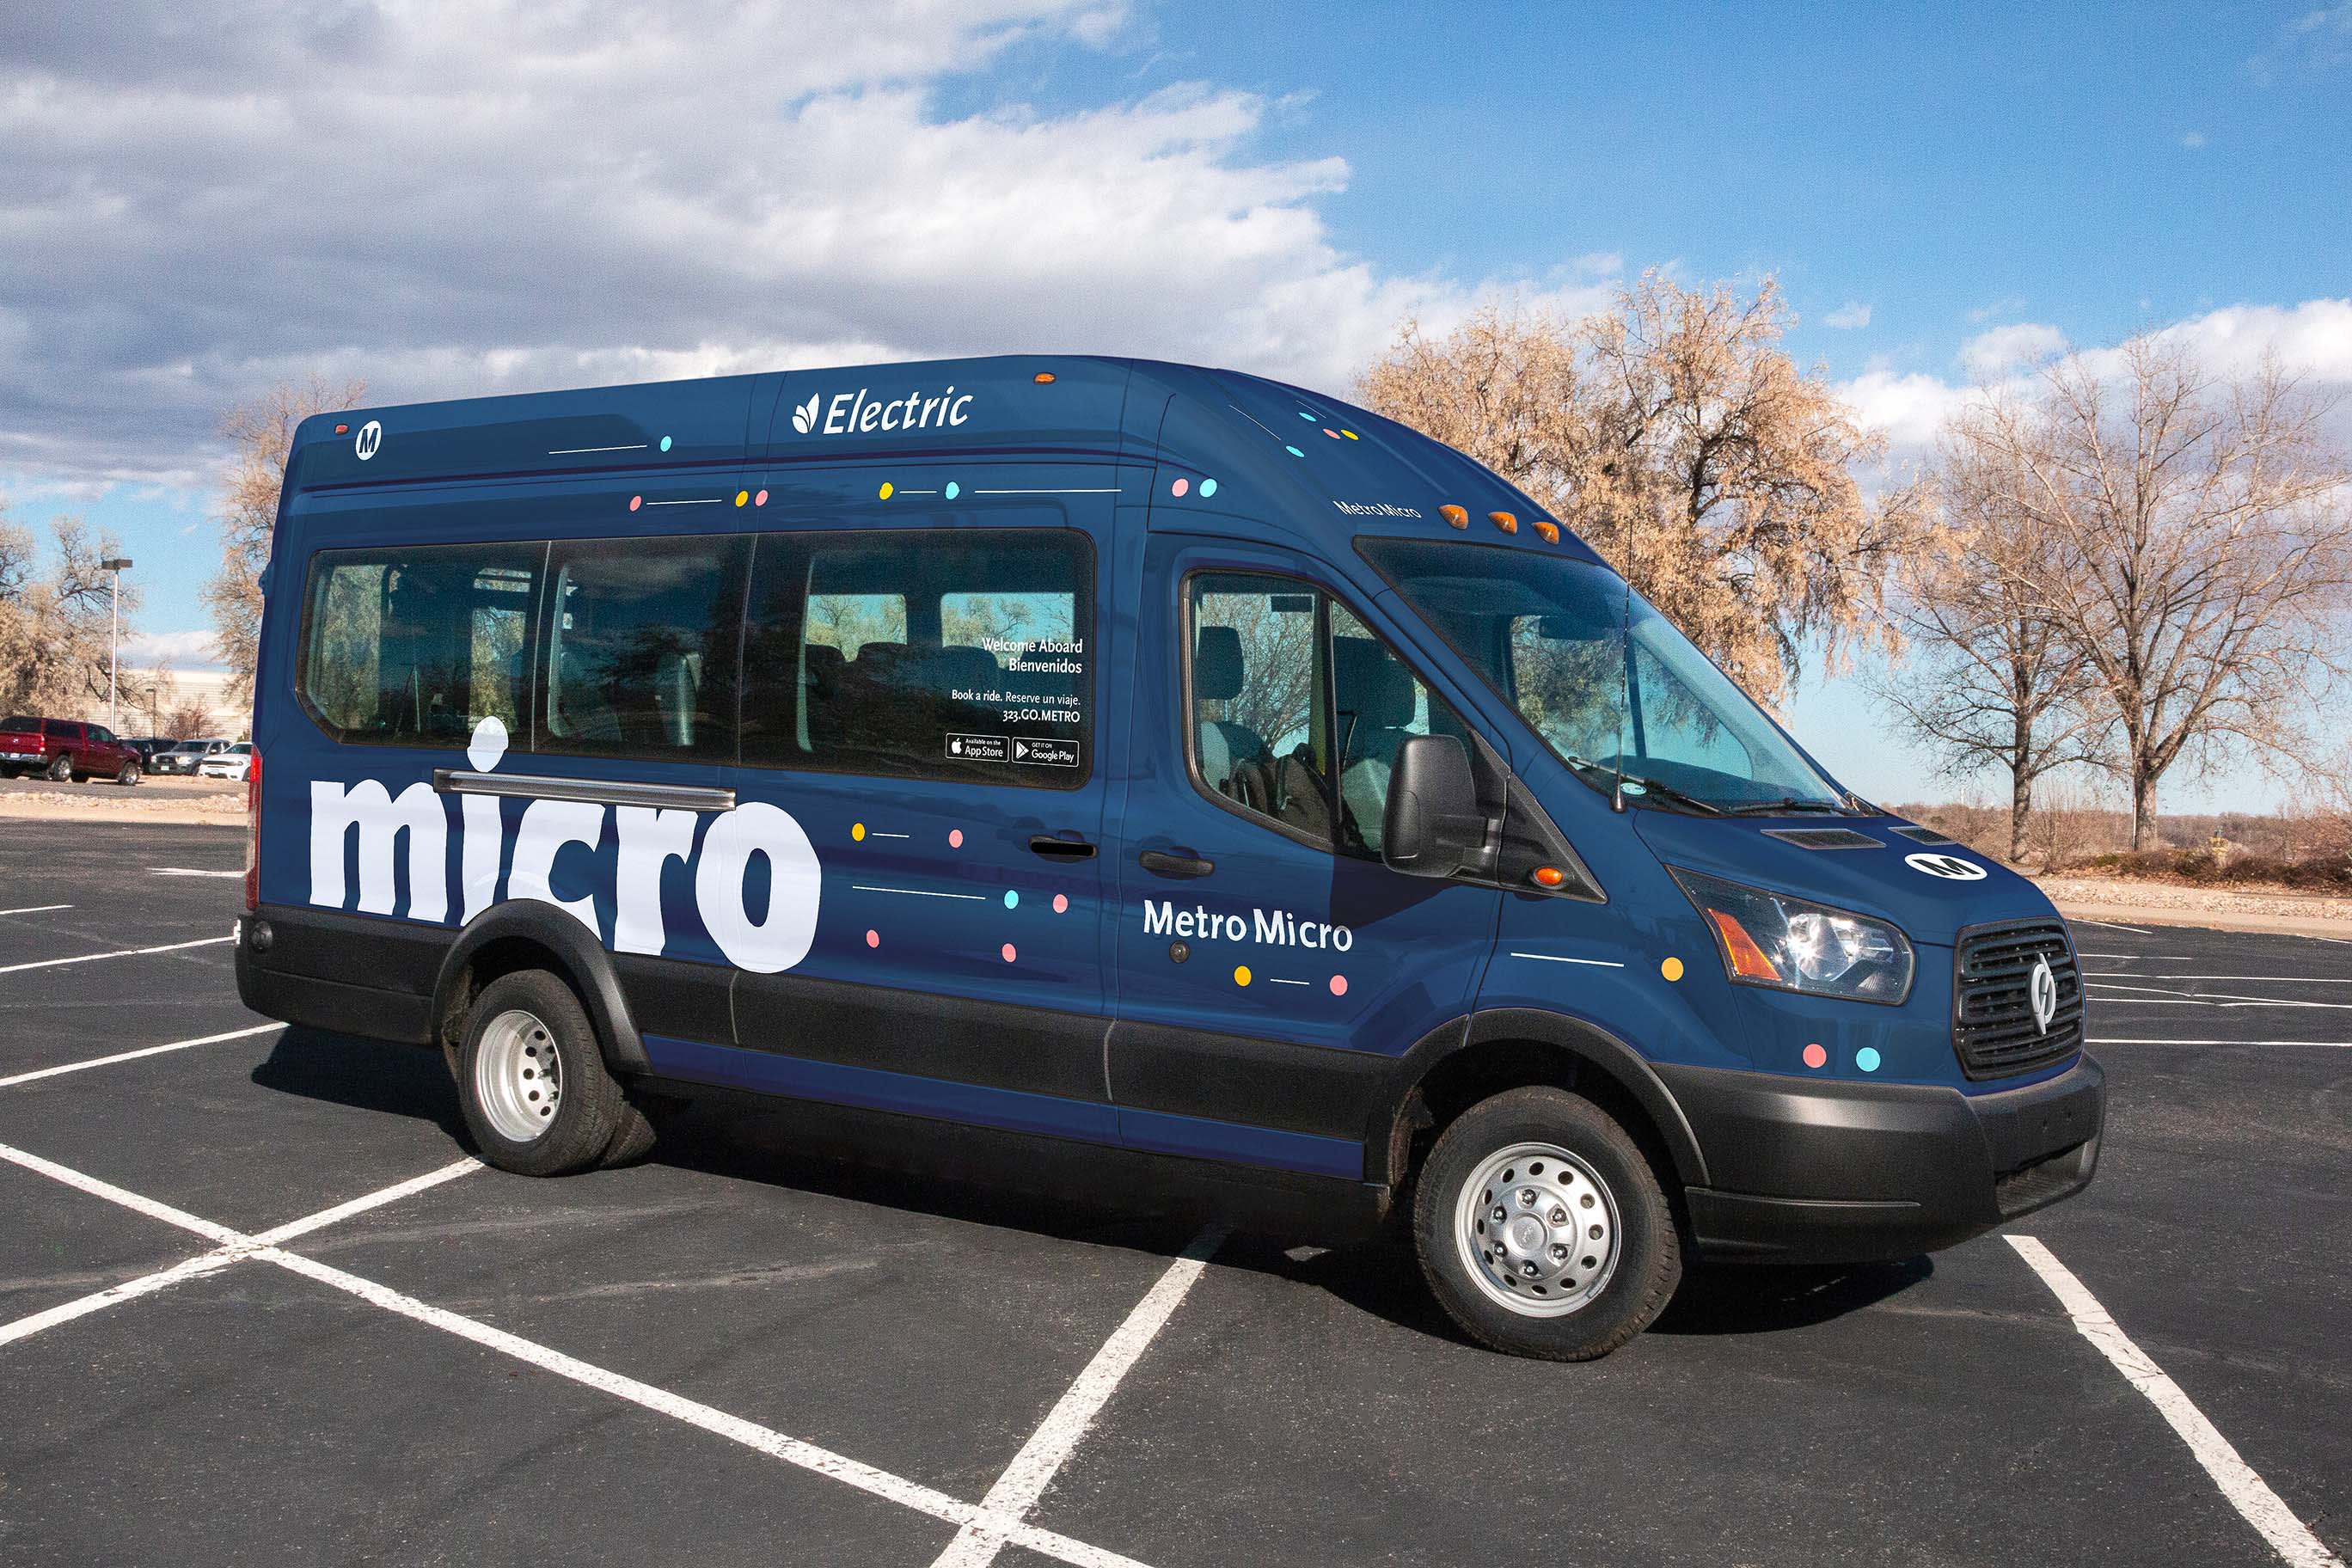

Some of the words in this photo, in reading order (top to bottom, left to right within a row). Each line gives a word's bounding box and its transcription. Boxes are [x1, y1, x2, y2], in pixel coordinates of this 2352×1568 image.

[823, 385, 974, 434] Electric
[358, 427, 379, 453] M
[1332, 500, 1383, 516] Metro
[1376, 503, 1422, 518] Micro
[983, 638, 1036, 652] Welcome
[1038, 639, 1083, 653] Aboard
[1008, 658, 1082, 674] Bienvenidos
[952, 689, 973, 701] Book
[983, 690, 1003, 701] ride.
[1005, 691, 1040, 703] Reserve
[1043, 695, 1055, 704] un
[1057, 694, 1081, 707] viaje.
[1002, 708, 1081, 723] 323.GO.METRO
[965, 745, 982, 757] App
[982, 746, 1003, 756] Store
[1032, 749, 1058, 762] Google
[1058, 750, 1075, 763] Play
[309, 715, 822, 974] micro
[1910, 857, 1982, 877] M
[1143, 899, 1247, 942] Metro
[1253, 908, 1354, 952] Micro
